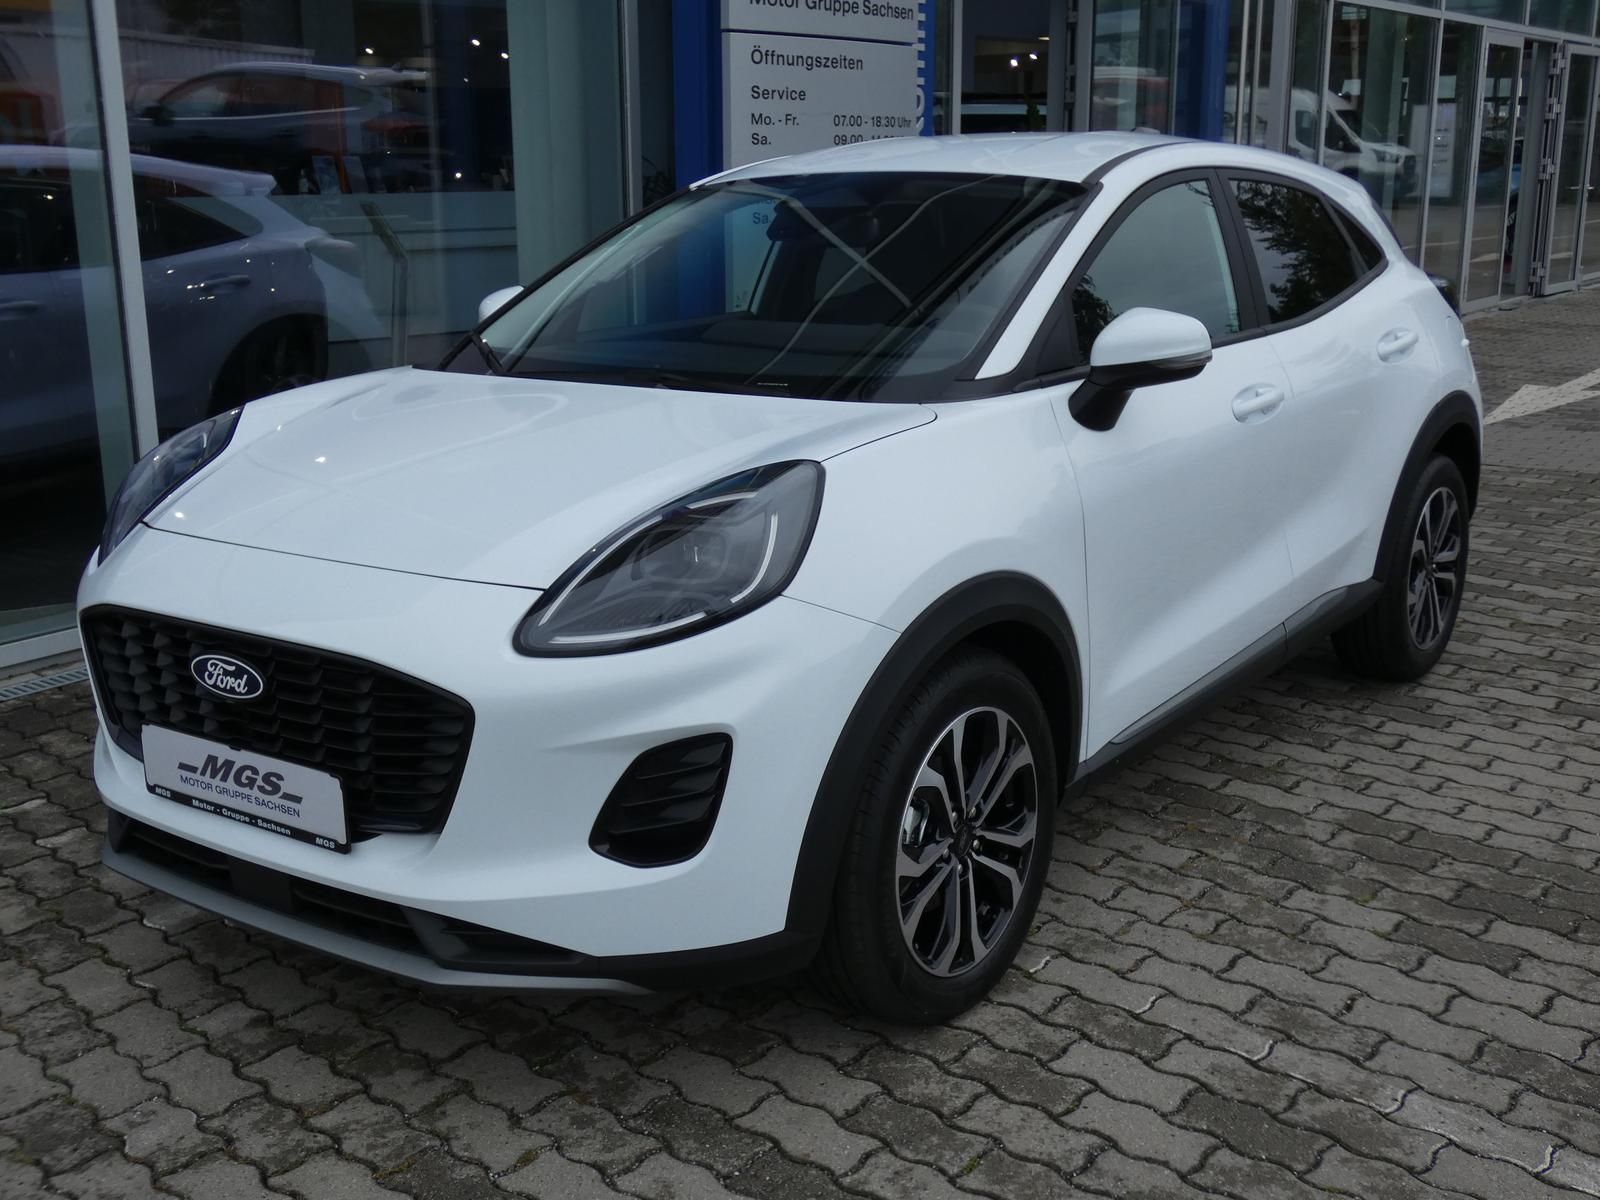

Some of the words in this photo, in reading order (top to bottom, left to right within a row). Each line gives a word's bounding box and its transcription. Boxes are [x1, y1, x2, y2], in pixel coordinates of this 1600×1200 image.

[804, 0, 859, 16] Gruppe
[862, 2, 914, 20] Sachsen
[751, 45, 863, 71] Öffnungszeiten
[751, 85, 806, 101] Service
[751, 113, 775, 126] Mo.
[785, 113, 799, 126] Fr.
[833, 114, 862, 127] 07.00
[871, 115, 896, 128] 18.30
[897, 116, 911, 128] Uhr
[751, 132, 771, 145] Sa.
[204, 659, 248, 693] Ford
[155, 786, 171, 798] MGS
[179, 774, 214, 792] MOTOR
[215, 785, 254, 804] GRUPPE
[254, 796, 300, 818] SACHSEN
[192, 798, 214, 812] Motor
[222, 807, 250, 823] Gruppe
[257, 818, 291, 835] Sachsen
[315, 837, 336, 849] MGS
